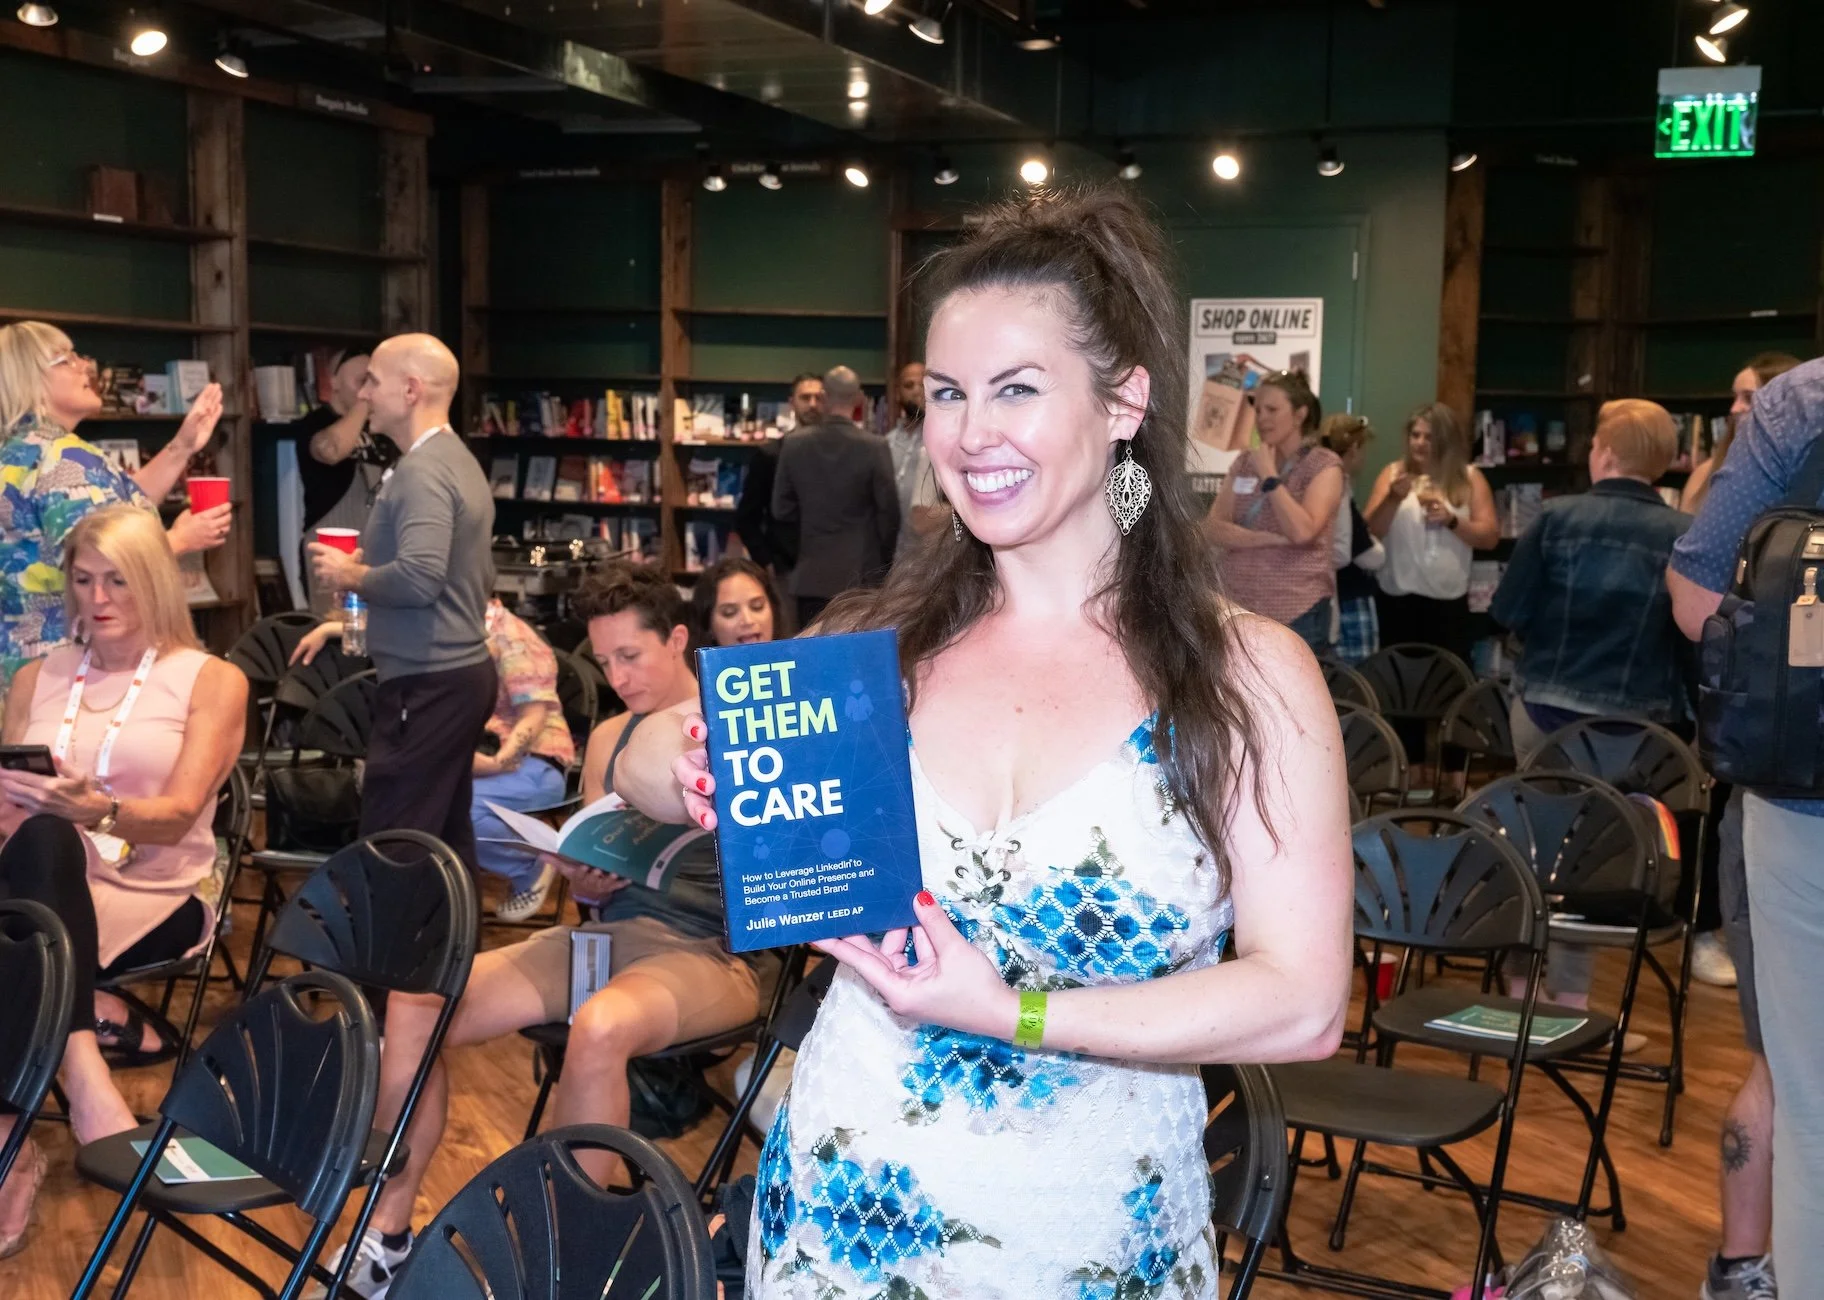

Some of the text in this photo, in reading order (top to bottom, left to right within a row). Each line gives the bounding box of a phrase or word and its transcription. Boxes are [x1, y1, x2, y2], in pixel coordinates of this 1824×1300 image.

[1670, 99, 1748, 151] EXIT
[1201, 307, 1312, 329] SHOP ONLINE
[716, 660, 796, 703] GET
[718, 697, 838, 745] THEM
[723, 747, 784, 786] TO
[730, 779, 843, 827] CARE
[742, 873, 762, 883] How
[764, 872, 773, 880] to
[775, 866, 814, 879] Leverage
[853, 859, 862, 867] to
[743, 868, 875, 894] Build Your Online Presence and
[744, 883, 849, 905] Become a Trusted Brand
[746, 906, 864, 931] Julie Wanzer LEED AP
